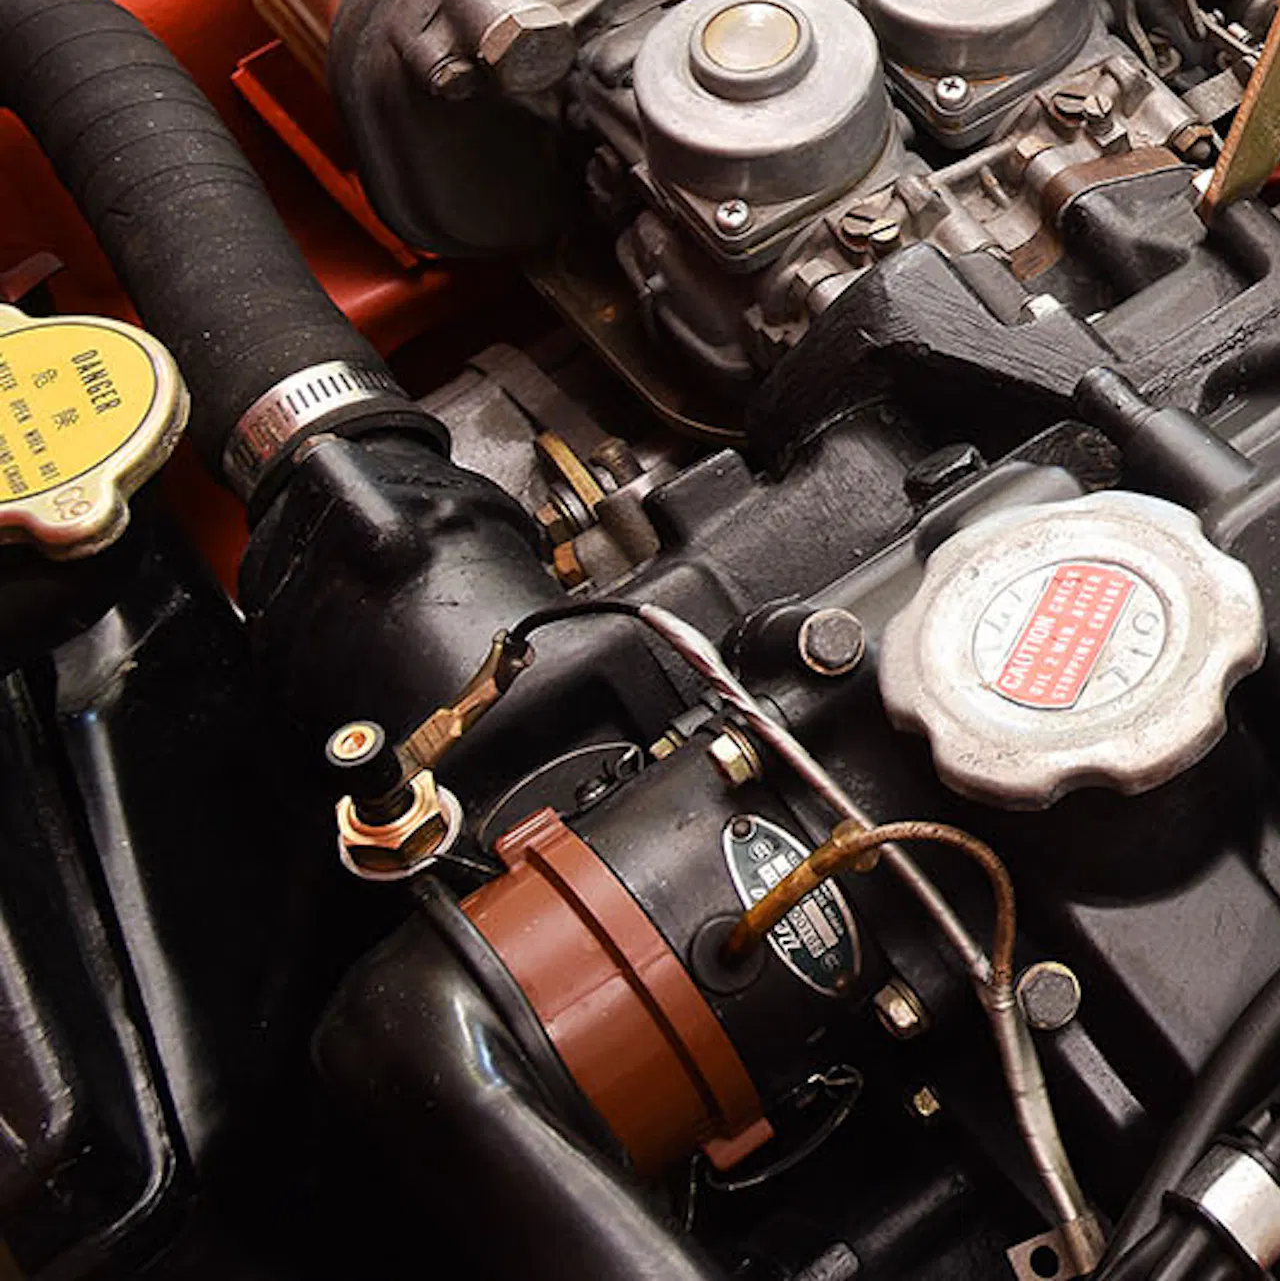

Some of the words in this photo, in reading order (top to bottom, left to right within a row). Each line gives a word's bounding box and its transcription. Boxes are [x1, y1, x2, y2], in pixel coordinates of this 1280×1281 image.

[71, 349, 121, 415] DANGER
[1000, 615, 1057, 690] CAUTION
[1029, 673, 1052, 696] OIL
[1044, 657, 1059, 668] 2
[1071, 575, 1102, 618] AFTER
[1051, 636, 1095, 699] STOPPING
[1089, 579, 1124, 629] ENGINE
